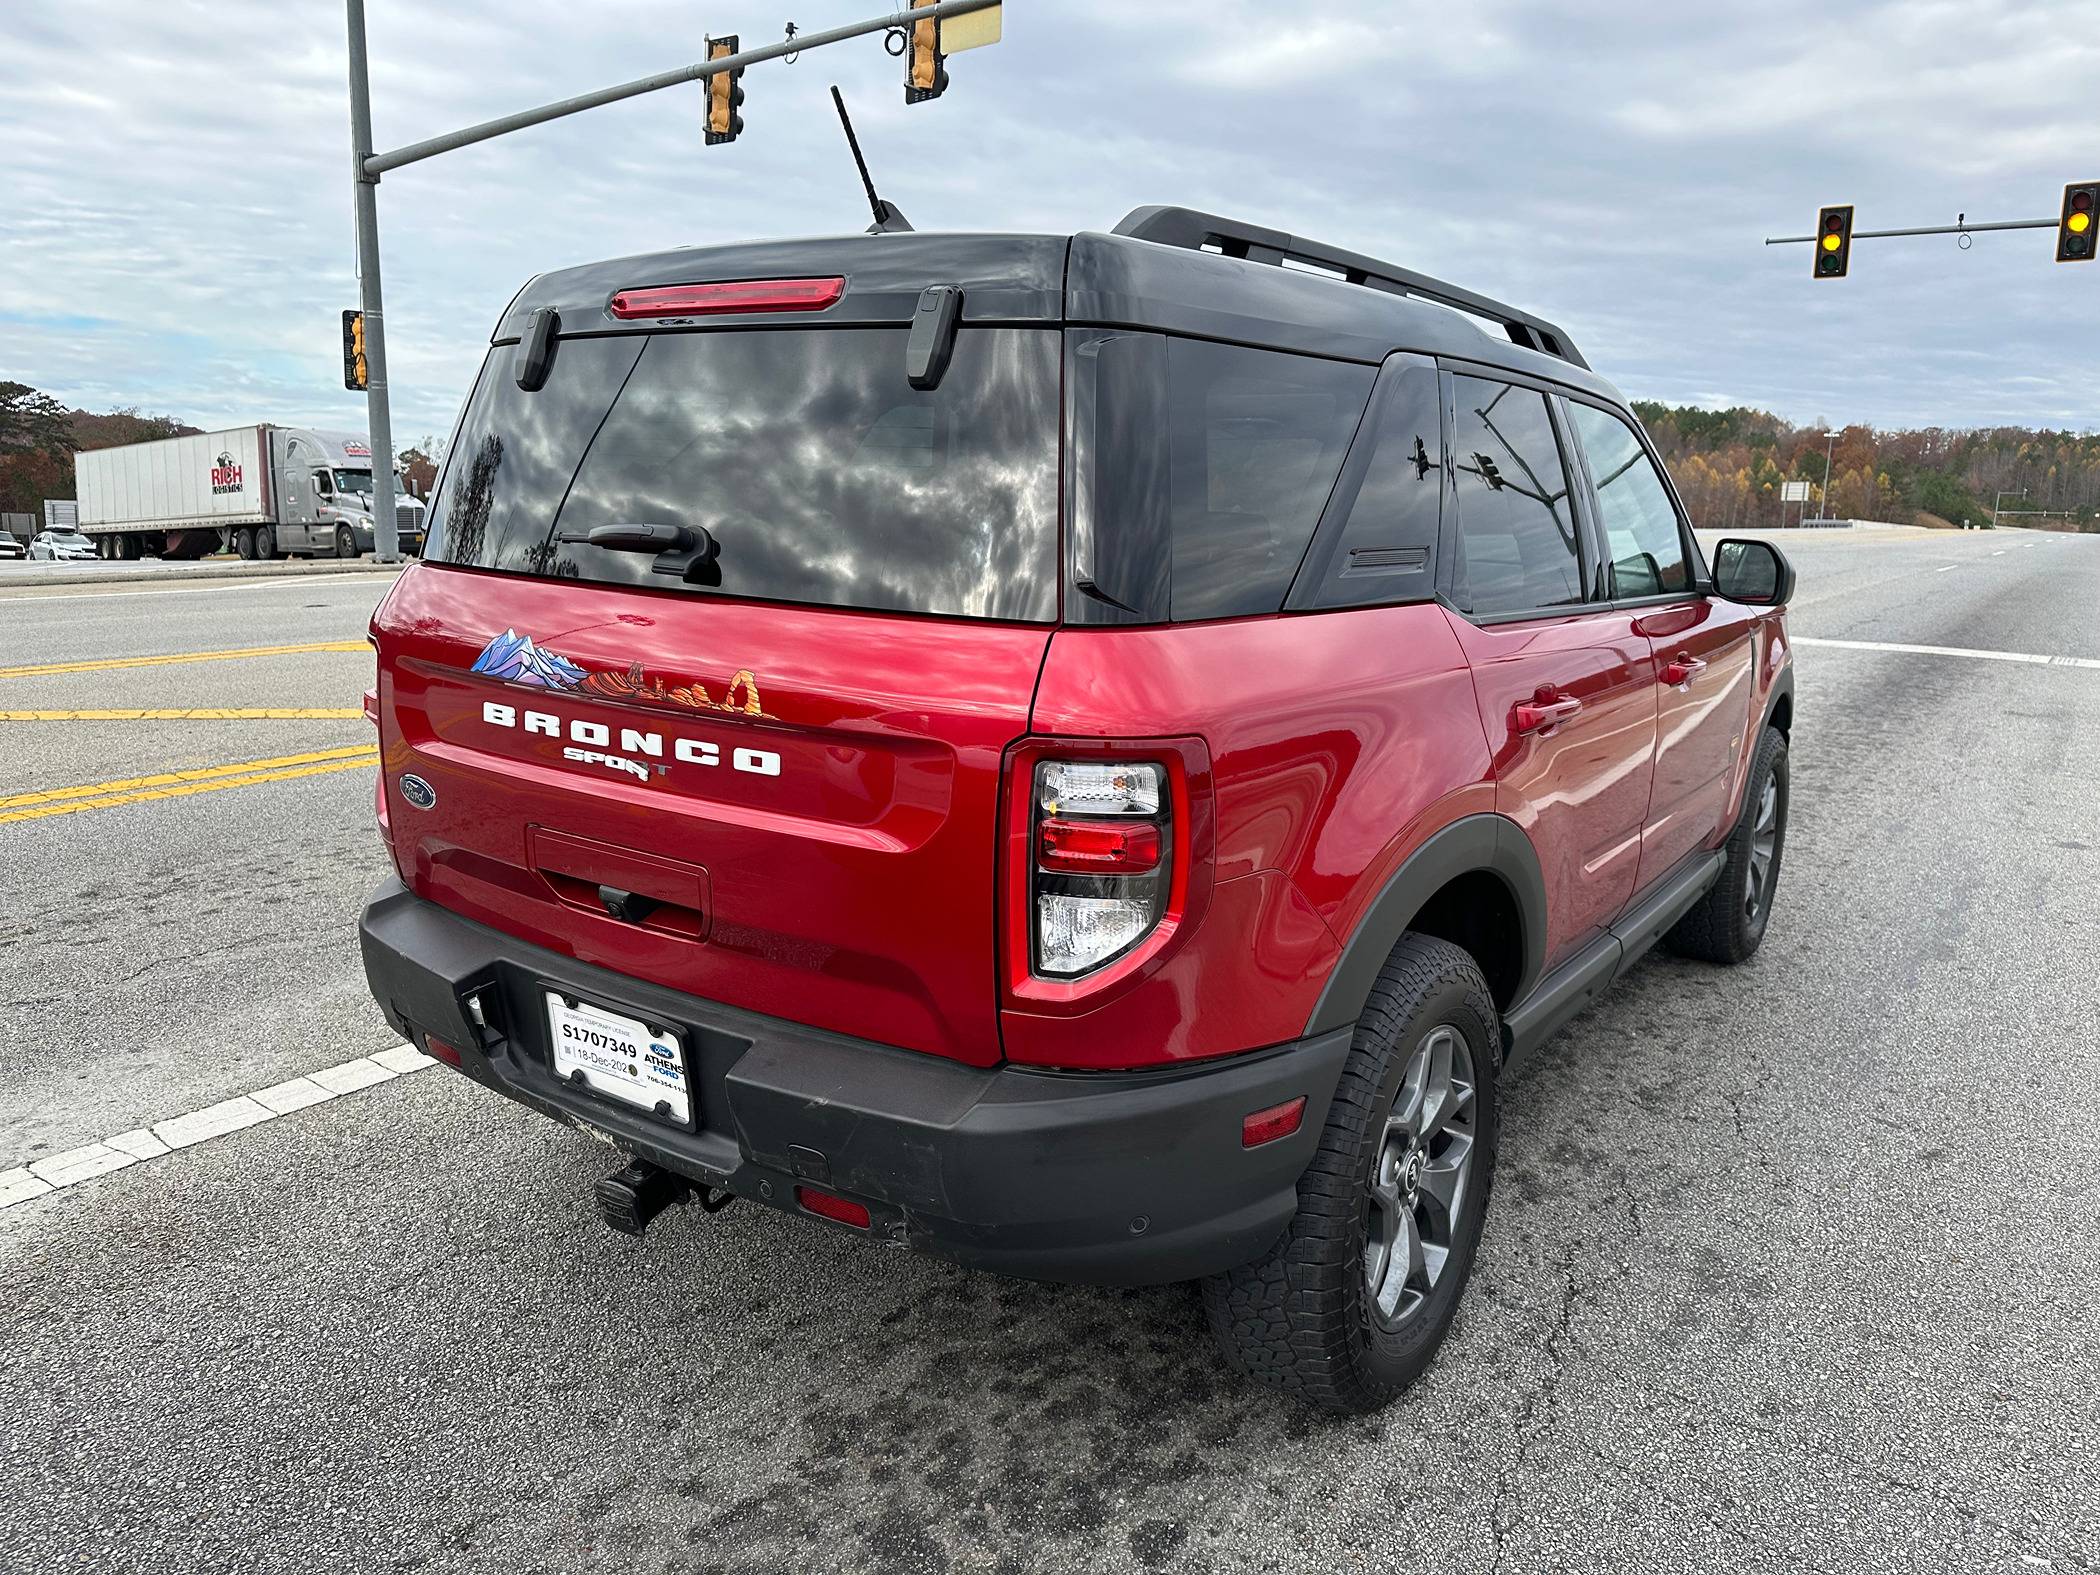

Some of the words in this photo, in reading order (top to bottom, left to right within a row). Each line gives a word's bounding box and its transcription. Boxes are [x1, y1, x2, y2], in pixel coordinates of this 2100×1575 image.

[211, 465, 243, 485] RICH
[483, 702, 780, 776] BRONCO
[563, 747, 673, 781] SPORT
[563, 1012, 584, 1022] GEORGIA
[585, 1018, 612, 1030] TEMPORARY
[612, 1027, 632, 1037] LICENSE
[562, 1024, 637, 1058] S1707349
[652, 1044, 672, 1058] Ford
[578, 1049, 637, 1075] 18-Dec-202
[644, 1053, 684, 1075] ATHENS
[653, 1065, 679, 1080] FORD
